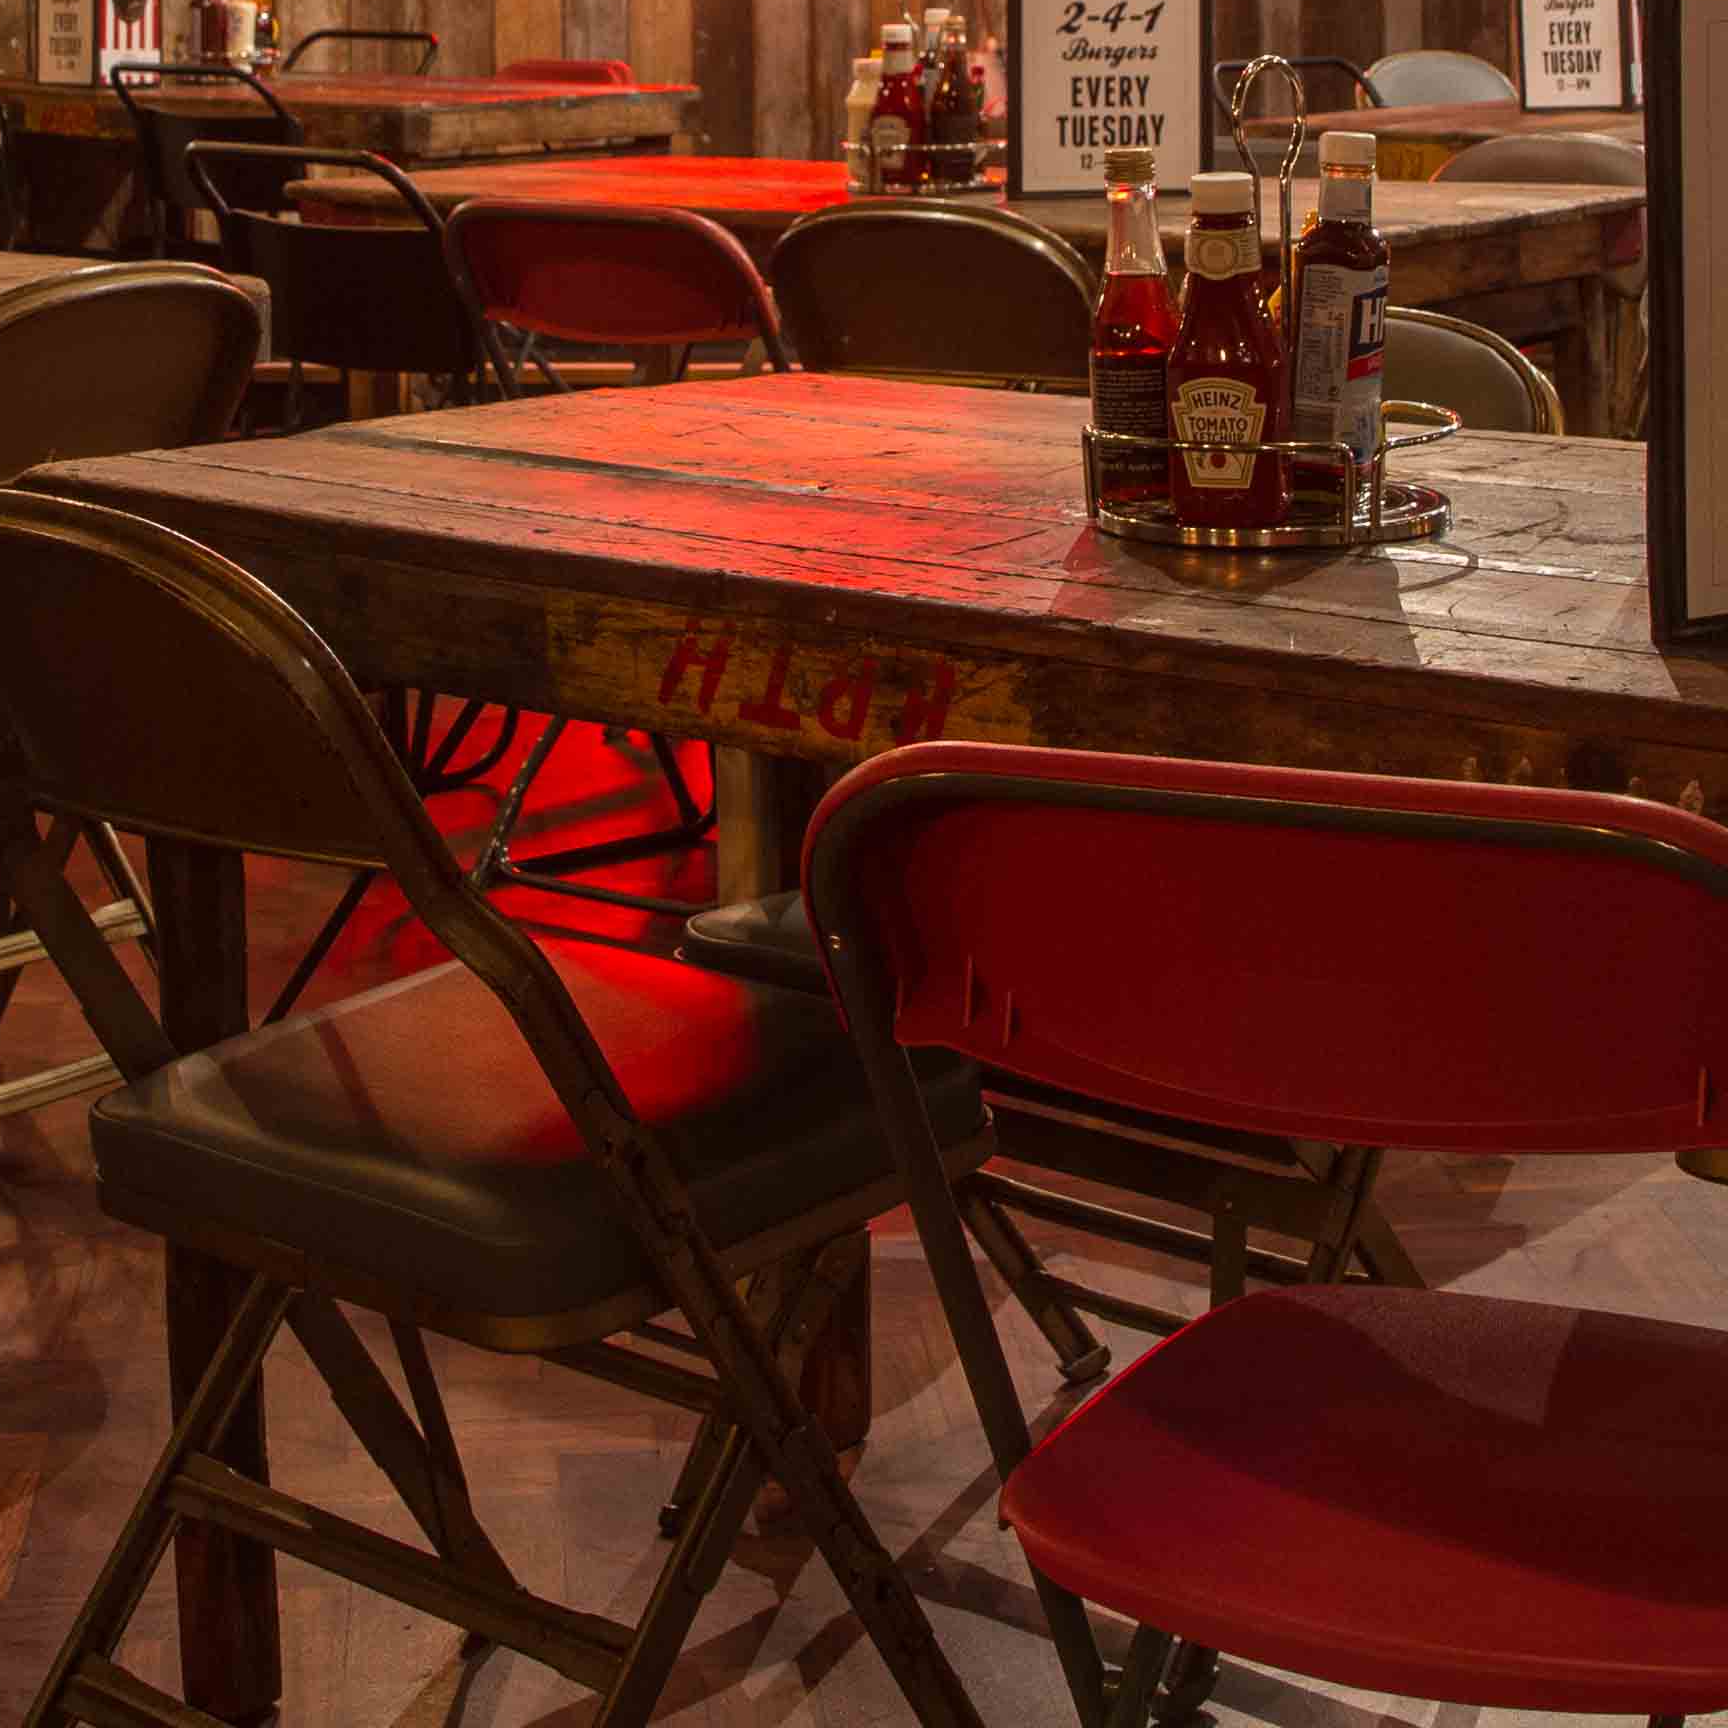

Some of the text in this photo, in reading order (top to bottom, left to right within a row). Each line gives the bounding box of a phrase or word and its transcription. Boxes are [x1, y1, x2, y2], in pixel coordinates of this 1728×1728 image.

[1057, 1, 1165, 34] 2-4-1
[1549, 21, 1592, 45] EVERY
[1062, 39, 1157, 68] Burgers
[1542, 49, 1602, 75] TUESDAY
[1071, 76, 1150, 108] EVERY
[1056, 115, 1165, 148] TUESDAY
[1192, 391, 1242, 410] HEINZ
[1188, 416, 1248, 432] TOMATO
